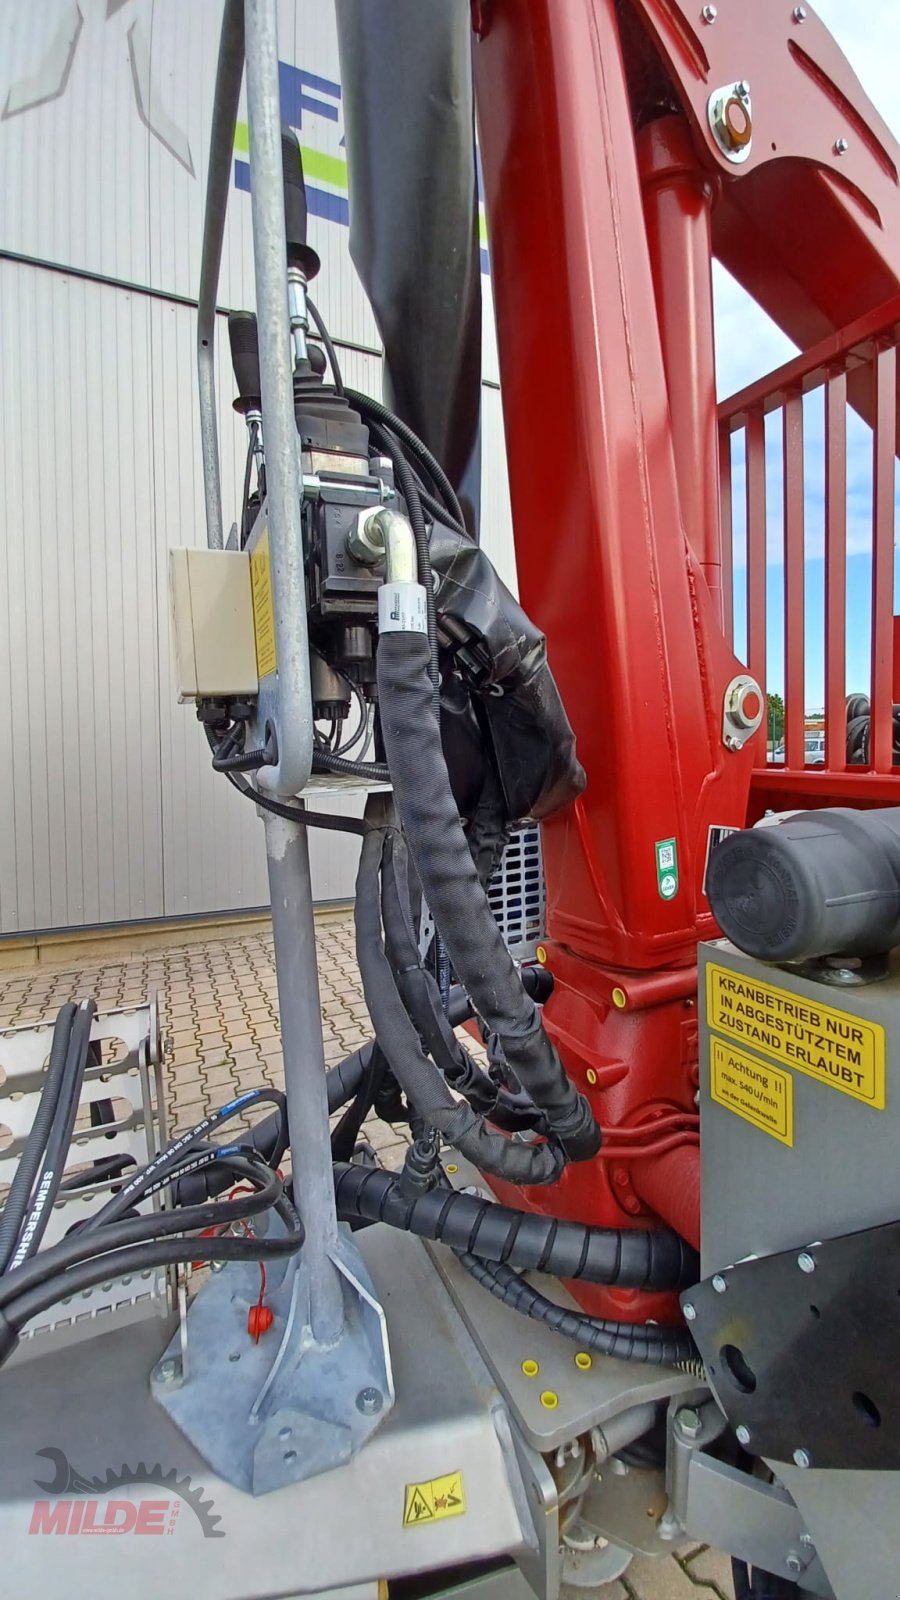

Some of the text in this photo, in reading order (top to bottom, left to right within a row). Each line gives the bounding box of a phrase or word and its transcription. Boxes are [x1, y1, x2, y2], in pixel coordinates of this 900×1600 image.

[719, 975, 864, 1046] KRANBETRIEB NUR
[721, 994, 862, 1067] IN ABGESTÜTZTEM
[719, 1011, 865, 1088] ZUSTAND ERLAUBT
[728, 1057, 769, 1089] Achtung
[721, 1072, 738, 1087] max.
[740, 1098, 778, 1125] Gelenkwelle
